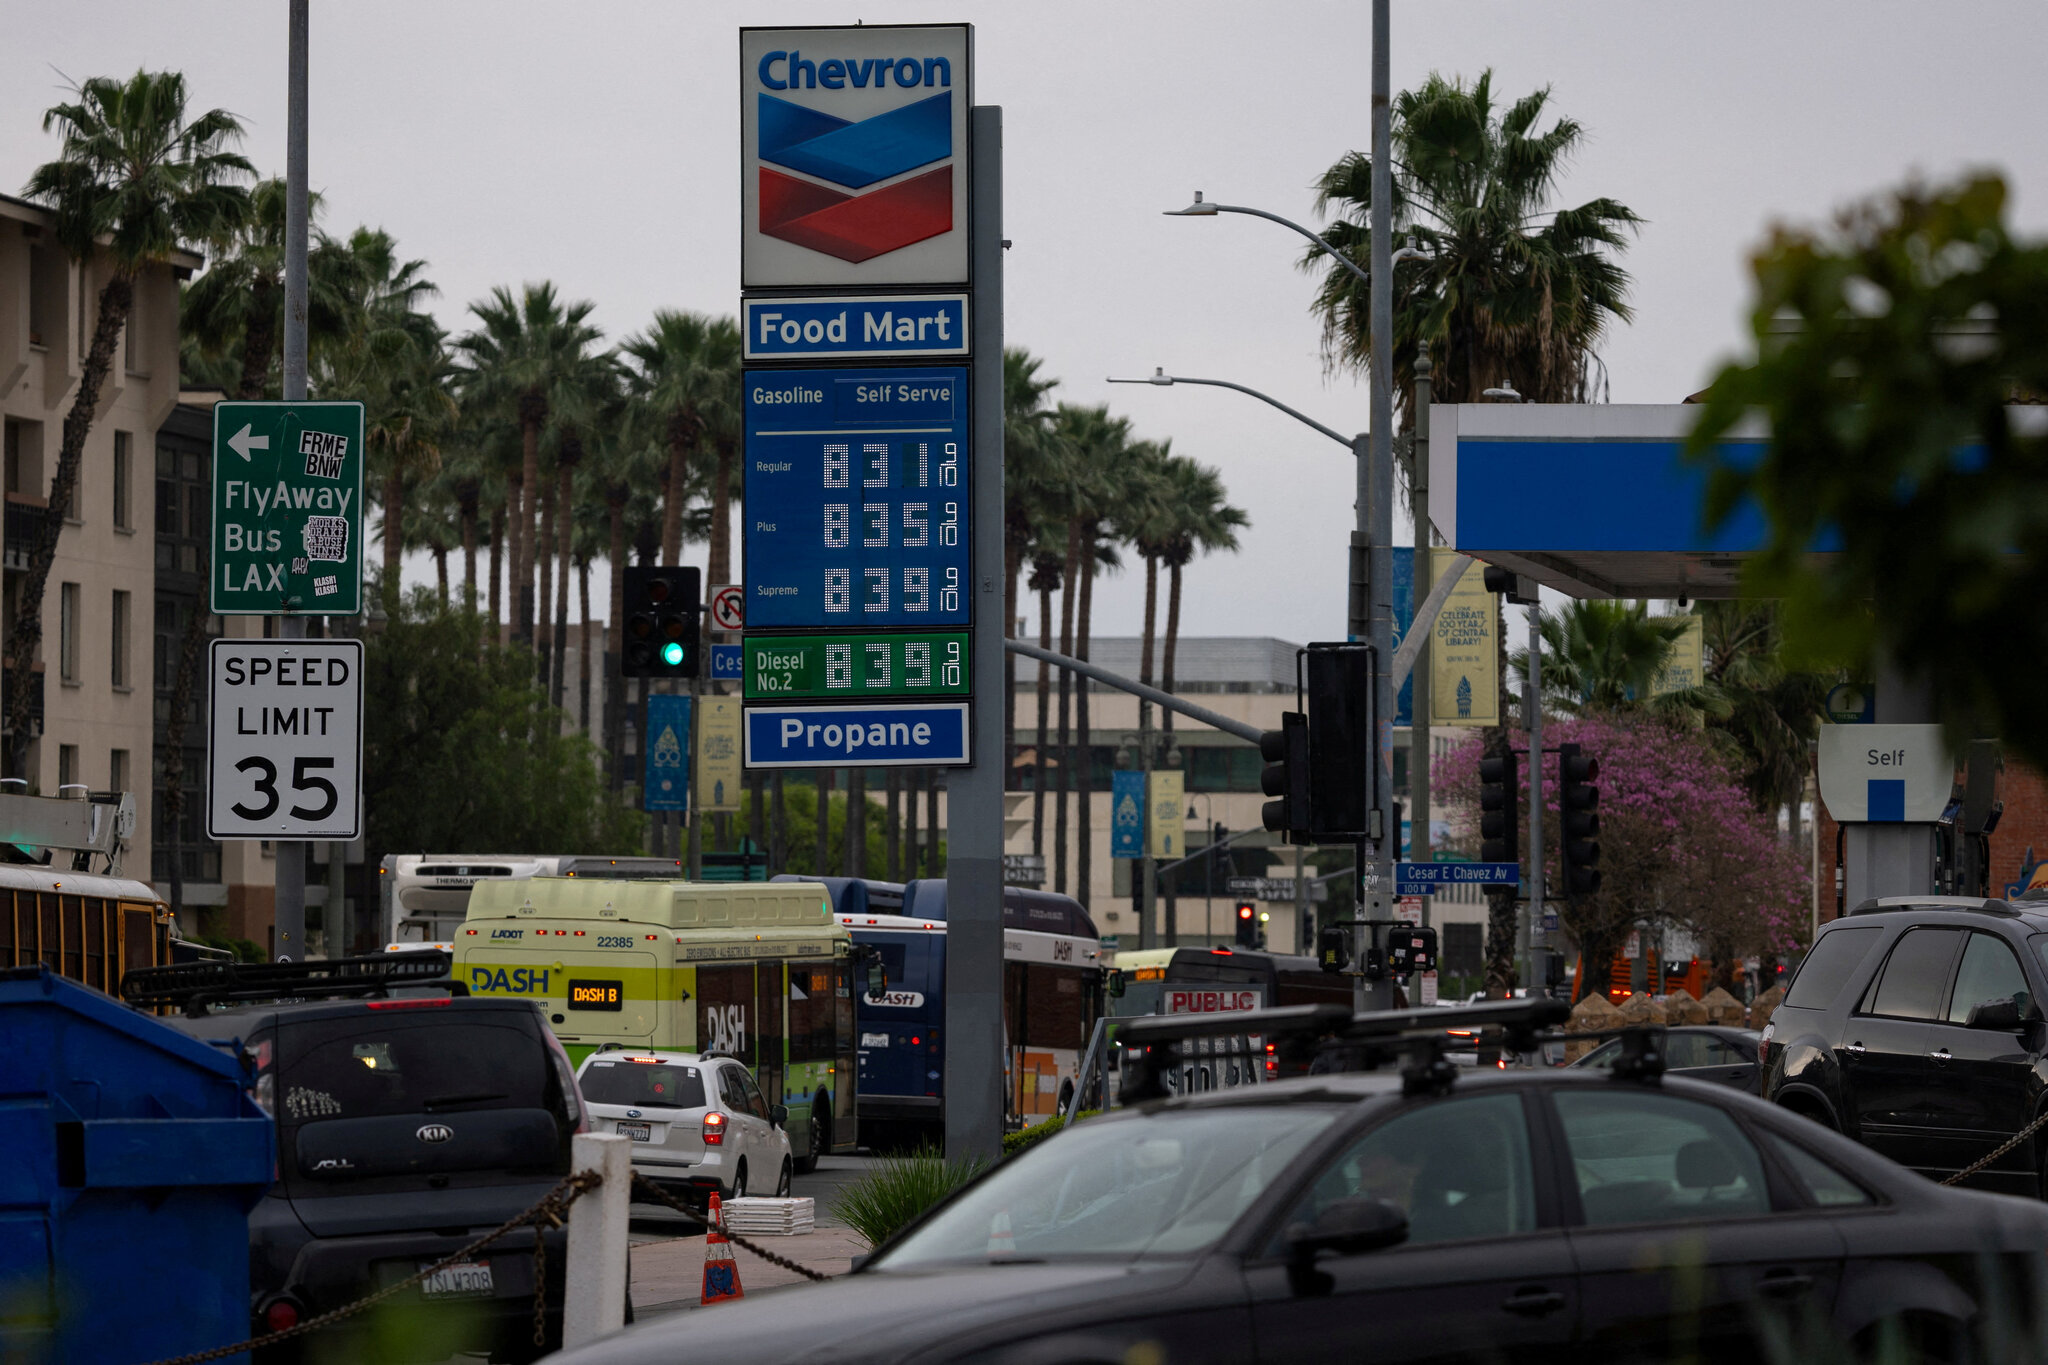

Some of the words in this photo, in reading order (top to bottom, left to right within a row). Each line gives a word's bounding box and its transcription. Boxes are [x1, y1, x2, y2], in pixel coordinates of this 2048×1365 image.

[758, 50, 951, 90] Chevron
[760, 311, 846, 344] Food
[863, 309, 951, 342] Mart
[753, 387, 823, 404] Gasoline
[856, 385, 891, 402] Self
[898, 385, 951, 402] Serve
[301, 432, 346, 457] FRME
[306, 453, 341, 478] BNW
[756, 460, 792, 474] Regular
[823, 443, 927, 488] 831
[225, 480, 353, 517] FlyAway
[756, 521, 776, 532] Plus
[823, 502, 928, 547] 835
[224, 523, 281, 552] Bus
[310, 537, 342, 547] ABUSE
[310, 545, 341, 556] HINTS
[224, 563, 285, 591] LAX
[757, 585, 798, 598] Supreme
[824, 567, 929, 612] 839
[1441, 611, 1486, 620] CELEBRATE
[1452, 629, 1489, 637] CENTRAL
[225, 657, 349, 686] SPEED
[757, 650, 804, 670] Diesel
[826, 642, 931, 688] 839
[757, 673, 792, 691] No.2
[238, 707, 334, 735] LIMIT
[780, 718, 931, 753] Propane
[1868, 749, 1905, 766] Self
[231, 756, 338, 821] 35
[1408, 866, 1438, 880] Cesar
[1442, 866, 1449, 880] E
[1454, 866, 1491, 880] Chavez
[1494, 866, 1507, 880] Av
[1404, 884, 1419, 893] 100
[1420, 884, 1427, 893] W
[491, 929, 524, 939] LADOT
[597, 936, 633, 948] 22385
[1054, 941, 1073, 962] DASH
[471, 968, 548, 993] DASH
[574, 988, 604, 1002] DASH
[608, 988, 617, 1002] B
[871, 993, 915, 1005] DASH
[1172, 992, 1254, 1012] PUBLIC
[707, 1004, 745, 1054] DASH
[422, 1127, 447, 1139] KIA
